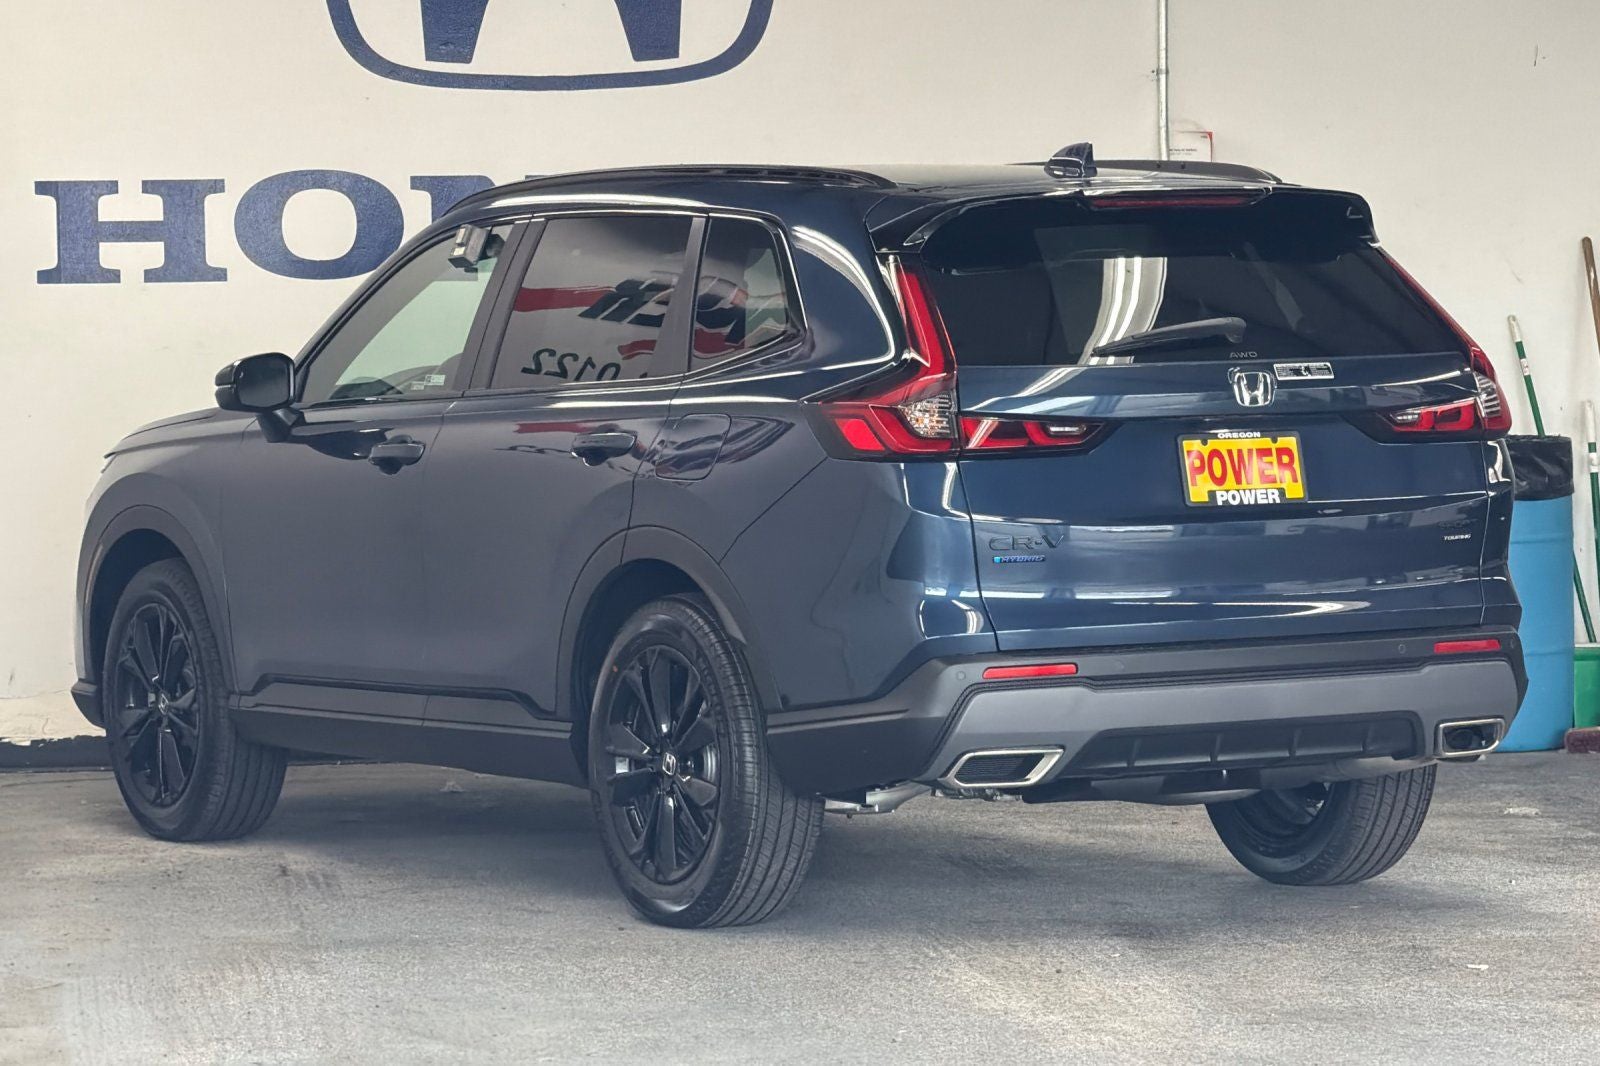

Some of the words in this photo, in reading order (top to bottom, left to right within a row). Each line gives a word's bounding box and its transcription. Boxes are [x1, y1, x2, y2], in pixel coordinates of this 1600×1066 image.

[1229, 351, 1258, 359] AWD
[1187, 447, 1298, 486] POWER
[1216, 489, 1280, 505] POWER
[989, 534, 1064, 550] CR-V
